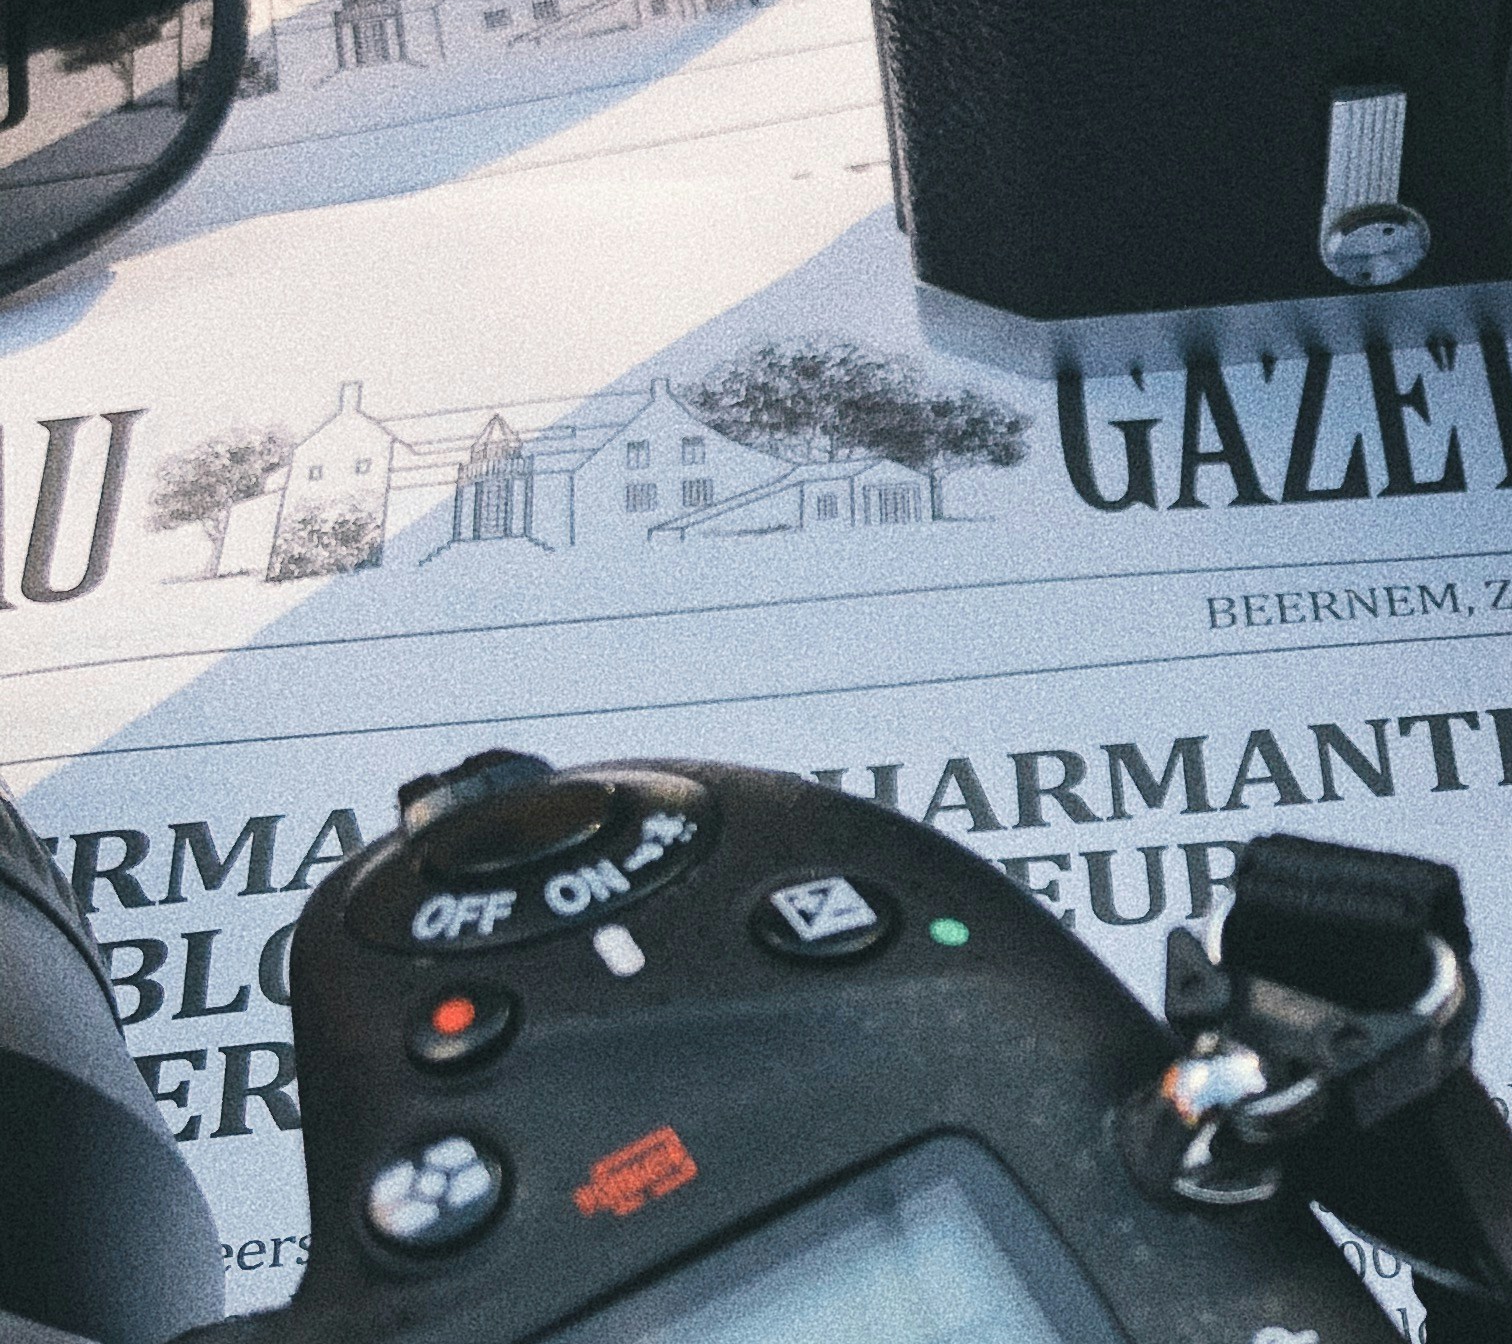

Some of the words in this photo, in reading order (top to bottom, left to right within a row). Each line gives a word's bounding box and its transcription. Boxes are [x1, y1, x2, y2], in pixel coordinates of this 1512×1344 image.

[1207, 583, 1475, 630] BEERNEM,
[42, 808, 366, 913] RMA
[410, 890, 517, 942] OFF
[544, 859, 632, 918] ON
